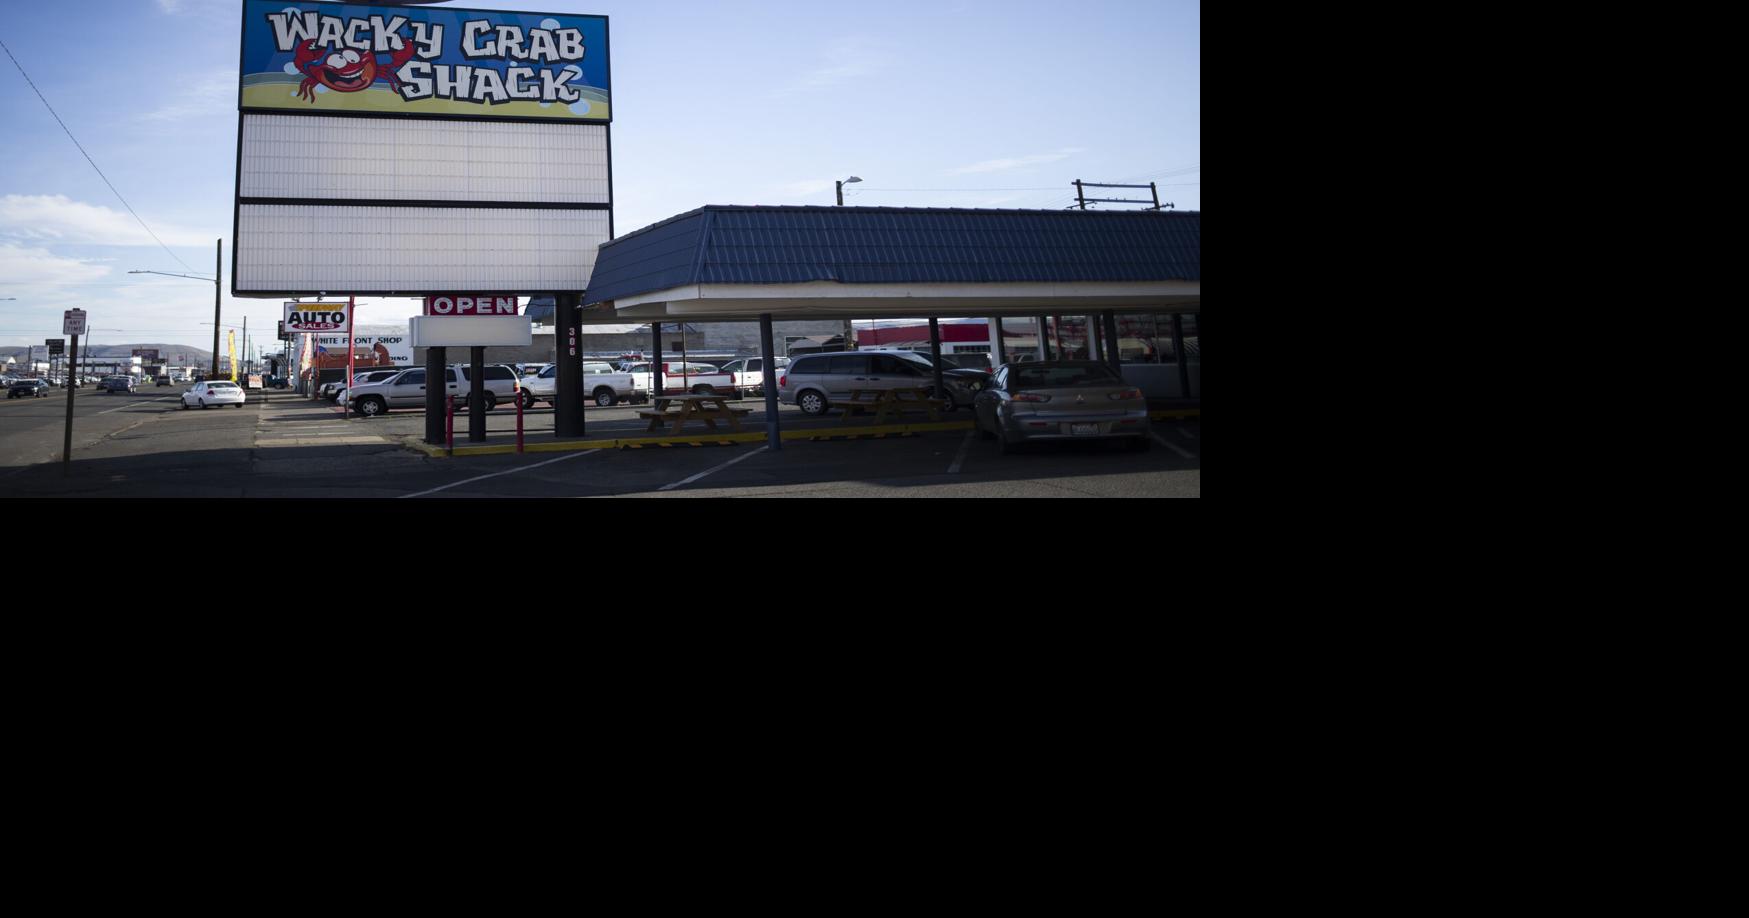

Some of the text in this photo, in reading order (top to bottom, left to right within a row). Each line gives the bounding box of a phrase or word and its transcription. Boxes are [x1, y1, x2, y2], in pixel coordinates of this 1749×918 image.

[266, 11, 586, 62] WACKY CRAB
[396, 62, 581, 104] SHACK
[433, 297, 514, 314] OPEN
[288, 312, 345, 324] AUTO
[378, 336, 402, 344] SHOP
[568, 327, 576, 356] 306
